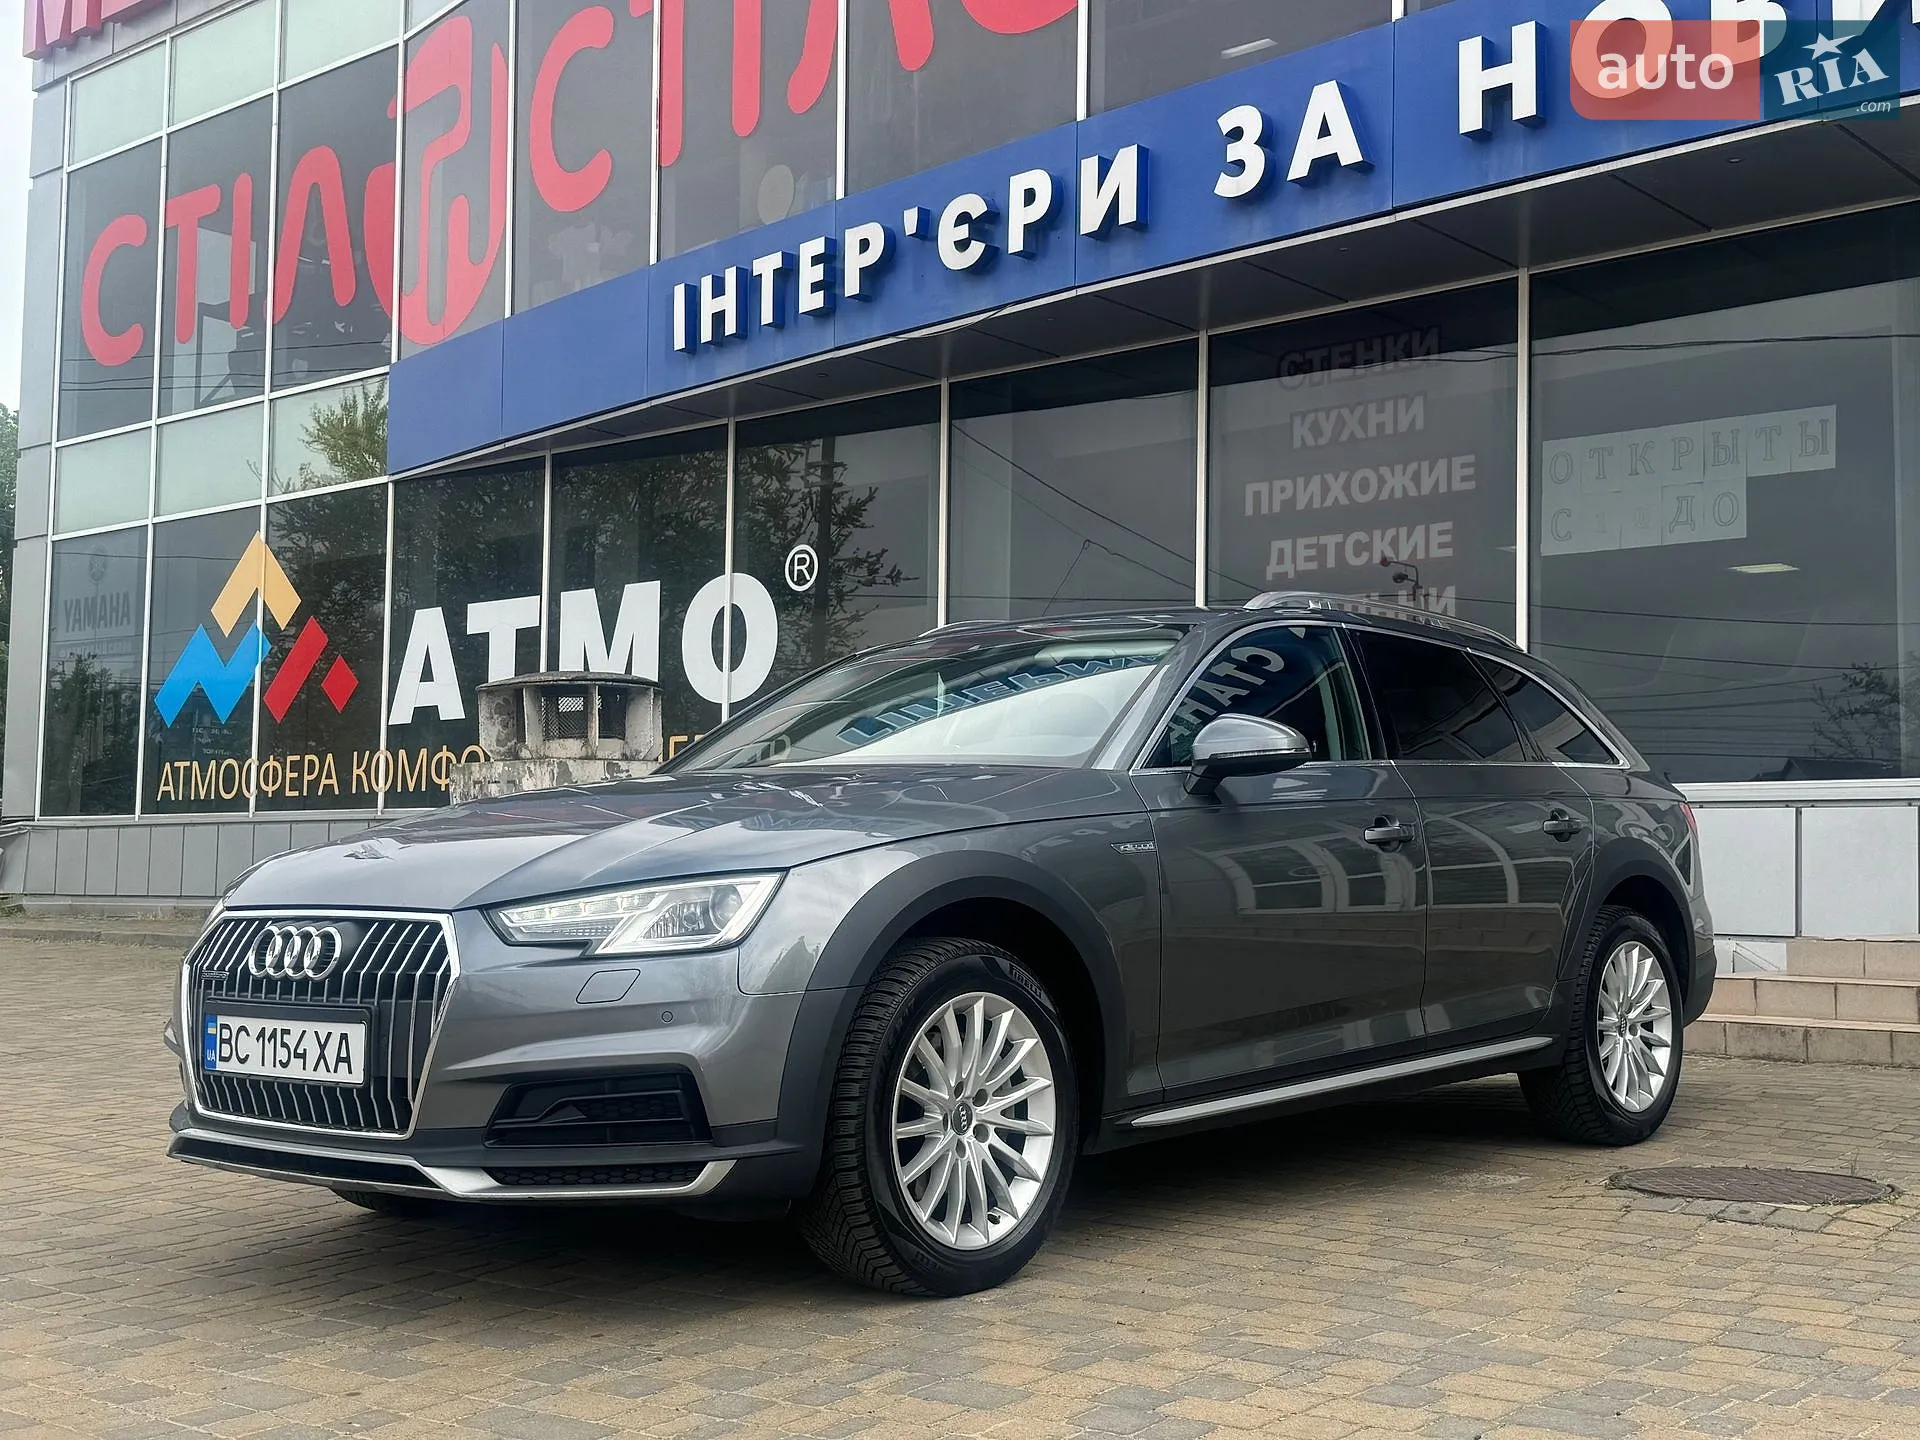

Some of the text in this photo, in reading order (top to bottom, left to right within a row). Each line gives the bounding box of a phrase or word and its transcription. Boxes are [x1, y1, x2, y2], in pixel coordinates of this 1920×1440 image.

[673, 144, 1146, 353] ІНТЕР'ЄРИ
[1214, 79, 1370, 198] ЗА
[1278, 326, 1440, 391] СТЕНКИ
[1291, 394, 1426, 449] КУХНИ
[1549, 417, 1831, 485] ОТКРЫТЫ
[1244, 454, 1476, 517] ПРИХОЖИЕ
[1668, 491, 1740, 534] ДО
[1266, 521, 1454, 581] ДЕТСКИЕ
[63, 591, 131, 633] YAMAHA
[388, 572, 779, 726] АТМО
[156, 752, 341, 802] АТМОСФЕРА
[218, 1023, 353, 1075] BC 1154 XA
